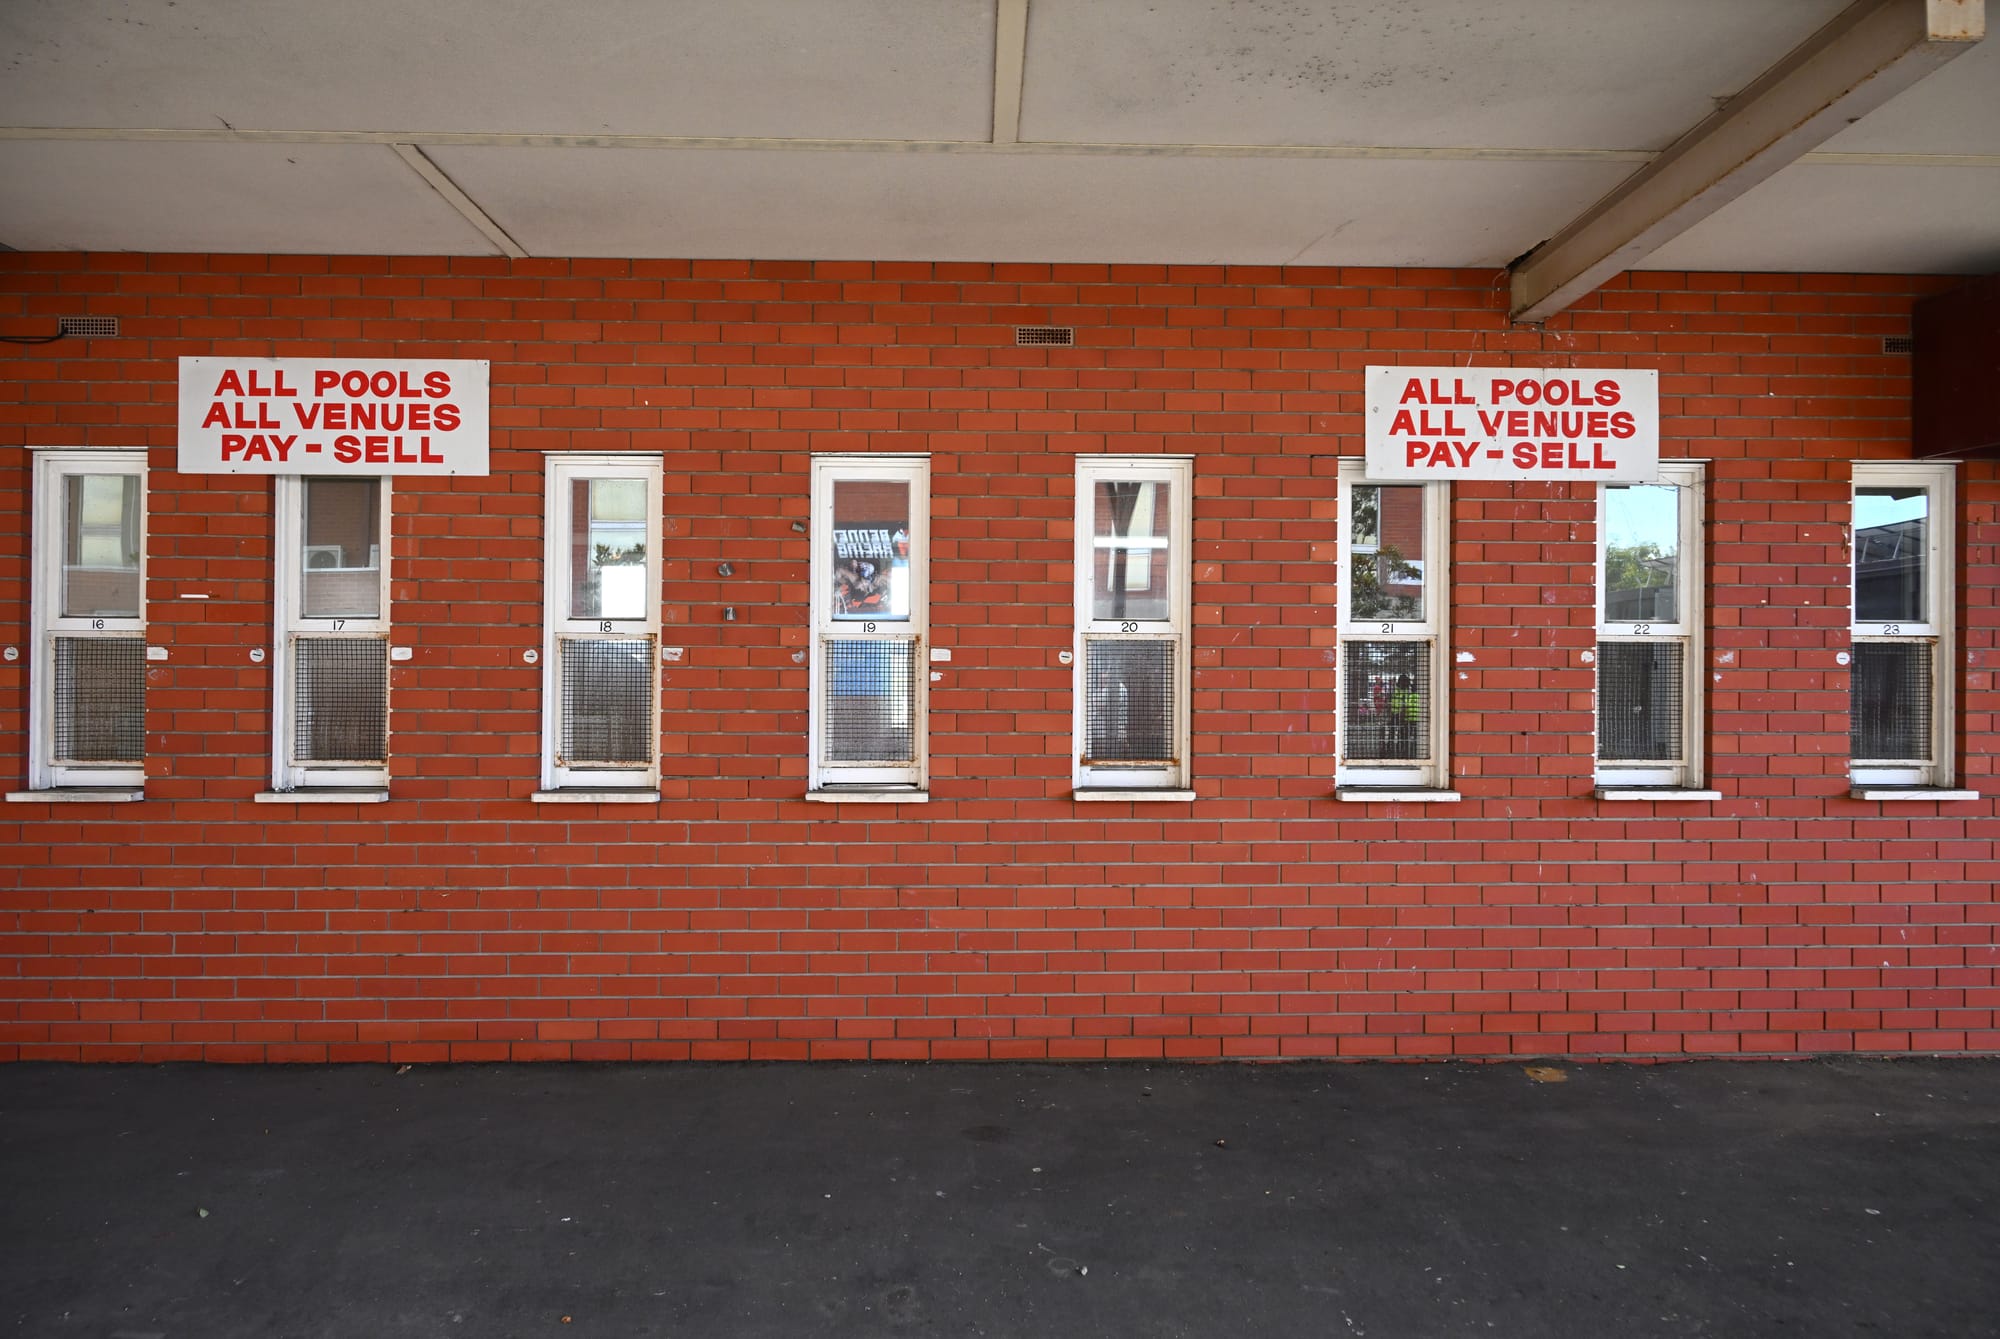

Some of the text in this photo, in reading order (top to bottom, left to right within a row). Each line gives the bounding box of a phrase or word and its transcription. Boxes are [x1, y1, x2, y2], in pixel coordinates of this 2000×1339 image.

[214, 370, 452, 399] ALL POOLS
[1399, 377, 1622, 407] ALL POOLS
[201, 402, 462, 432] ALL VENUES
[1389, 409, 1637, 439] ALL VENUES
[221, 433, 298, 462] PAY
[333, 435, 445, 464] SELL
[1406, 440, 1481, 468] PAY
[1512, 441, 1617, 470] SELL
[92, 619, 104, 629] 16
[333, 620, 345, 630] 17
[600, 621, 612, 632] 18
[863, 622, 876, 633] 19
[1121, 622, 1138, 632] 20
[1381, 623, 1394, 633] 21
[1634, 624, 1650, 634] 22
[1883, 624, 1900, 634] 23
